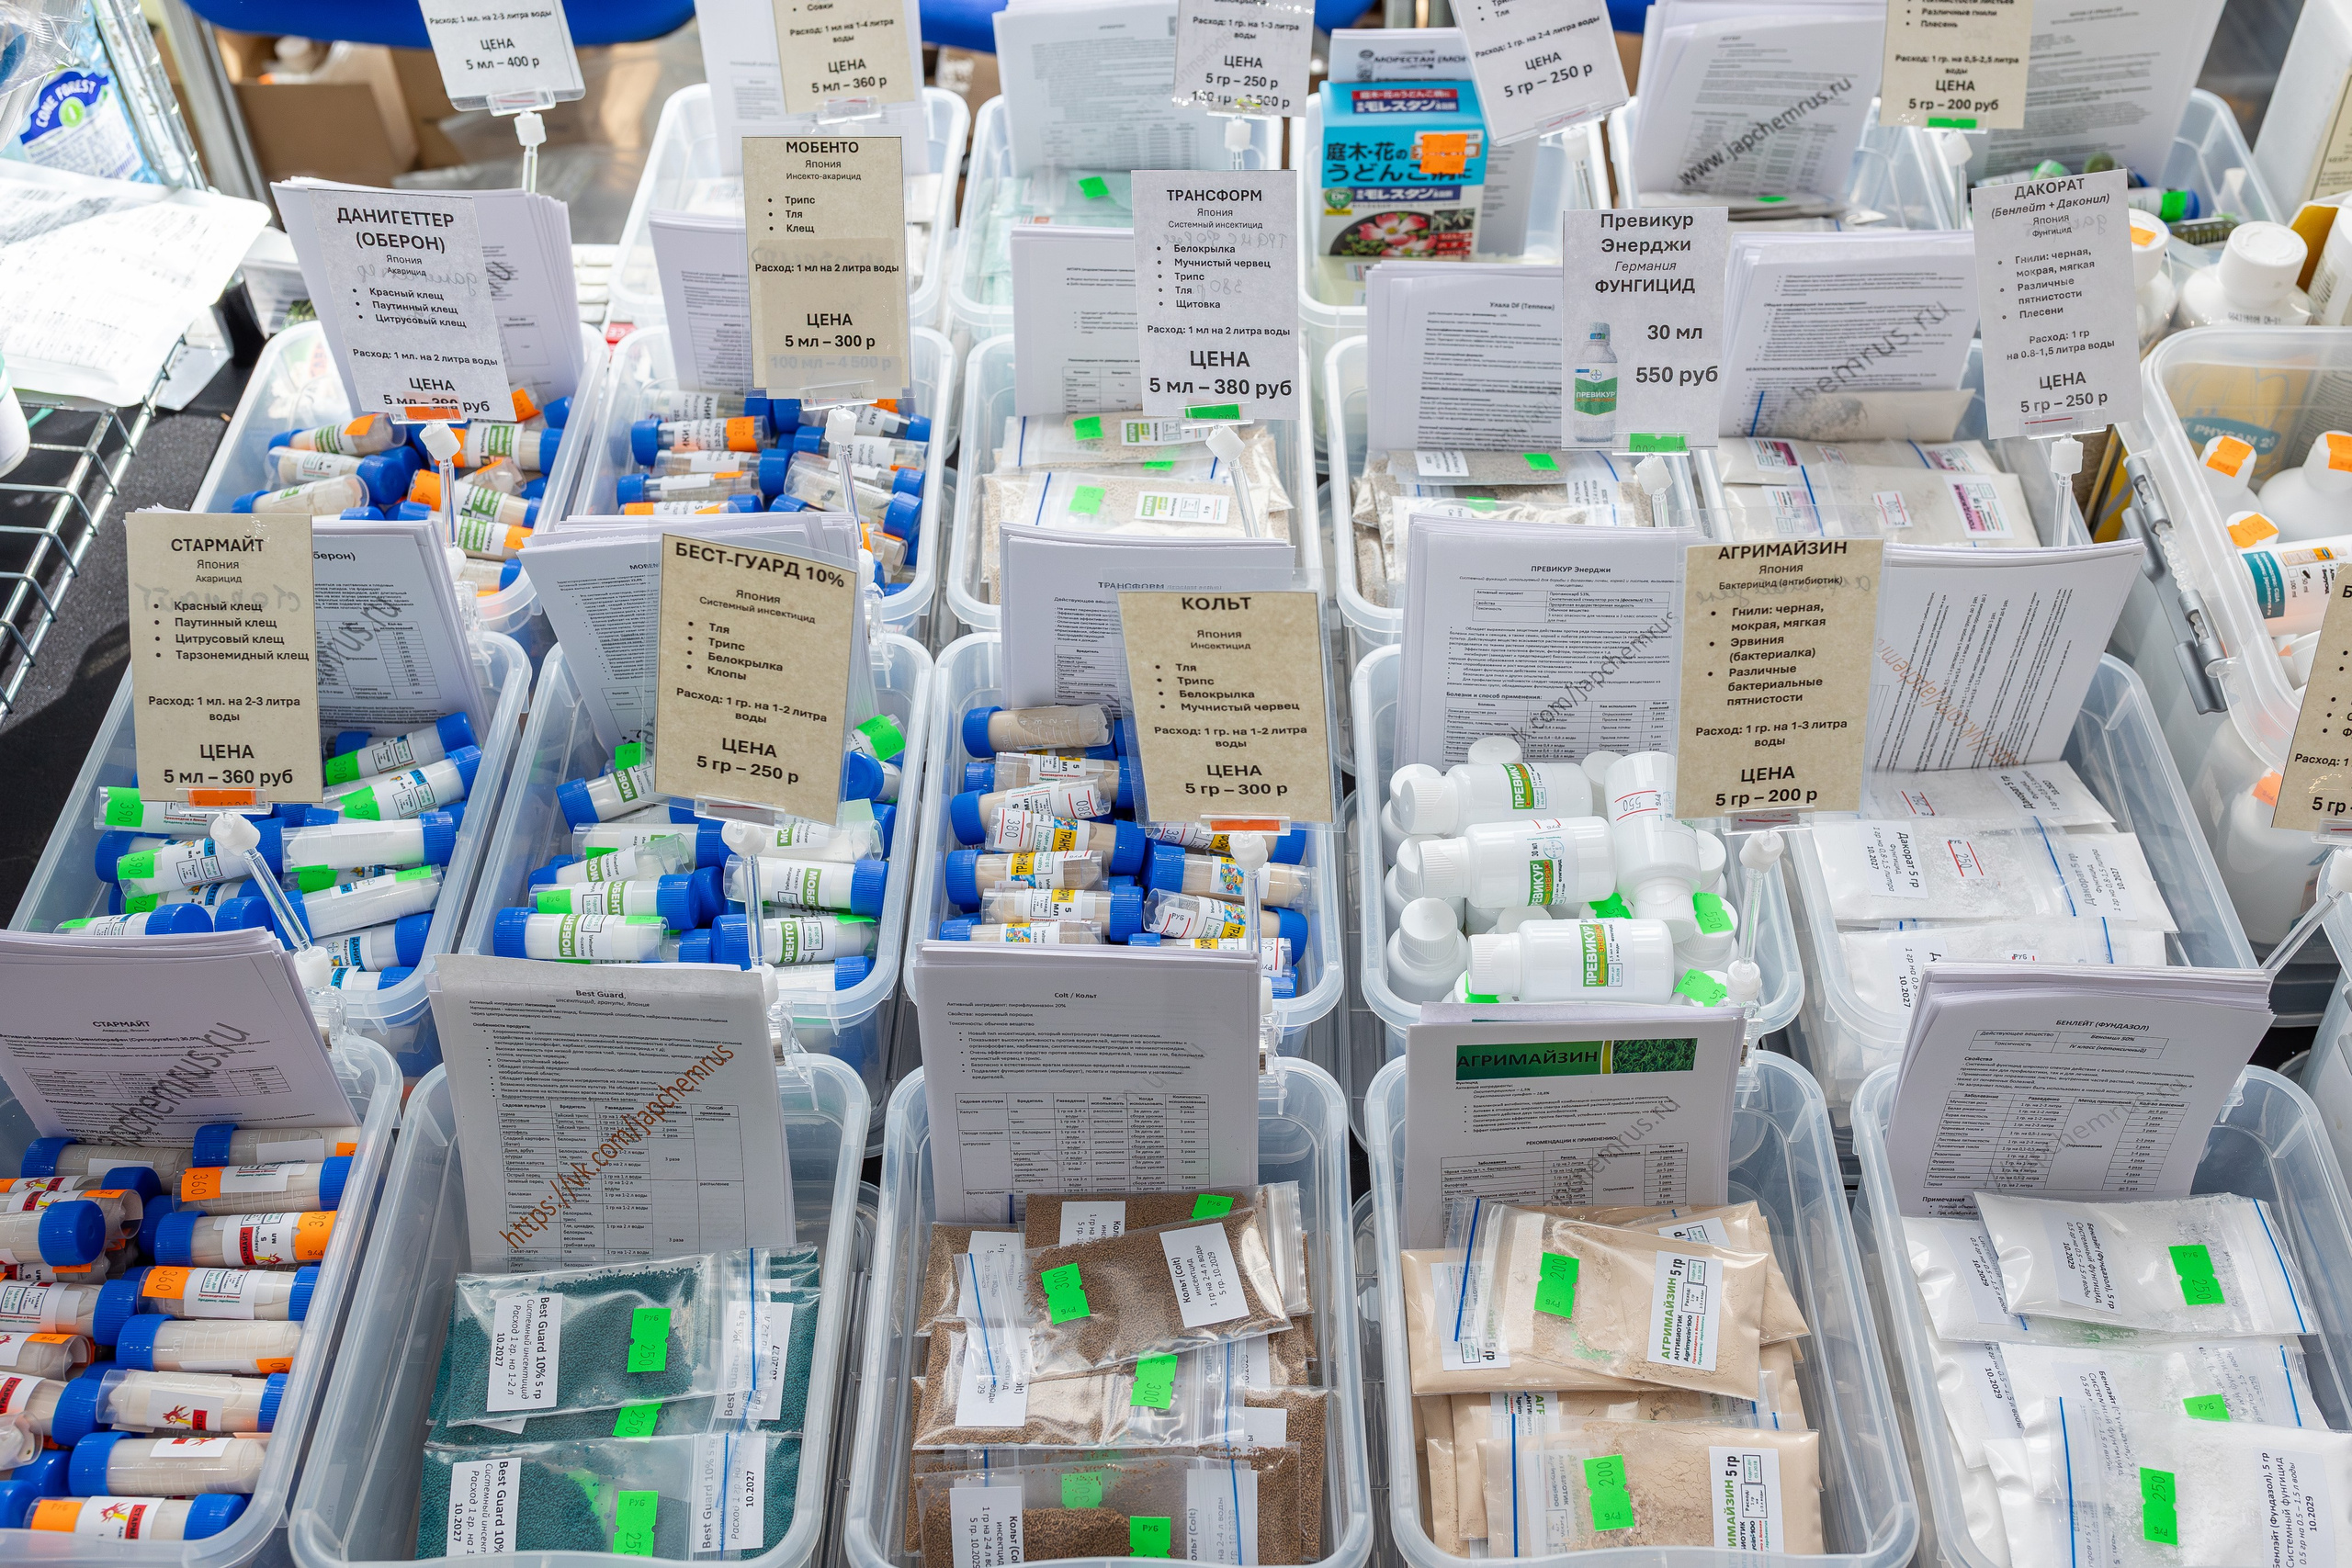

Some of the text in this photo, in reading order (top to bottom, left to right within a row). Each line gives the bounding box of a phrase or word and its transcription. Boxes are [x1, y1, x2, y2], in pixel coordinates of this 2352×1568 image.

[480, 38, 515, 52] ЦЕНА
[507, 55, 529, 67] 400
[828, 58, 866, 74] ЦЕНА
[1224, 55, 1263, 69] ЦЕНА
[1525, 51, 1562, 71] ЦЕНА
[853, 76, 876, 89] 360
[1243, 75, 1267, 87] 250
[1550, 65, 1578, 84] 250
[1935, 80, 1975, 93] ЦЕНА
[1947, 98, 1999, 113] 200 руб
[1679, 77, 1852, 186] www.japchemrus.ru
[786, 141, 859, 153] МОБЕНТО
[805, 159, 842, 168] Япония
[786, 173, 862, 181] Инсекто-акарицид
[1166, 189, 1262, 202] ТРАНСФОРМ
[2014, 177, 2085, 200] ДАКОРАТ
[785, 196, 816, 206] Трипс
[1991, 193, 2110, 220] (Бенлейт Даконил)
[336, 207, 454, 228] ДАНИГЕТТЕР
[1197, 208, 1233, 217] Япония
[2032, 214, 2070, 226] Япония
[786, 224, 815, 234] Клещ
[1168, 220, 1214, 229] Системный
[1600, 213, 1693, 231] Превикур
[2032, 227, 2073, 239] Фунгицид
[356, 231, 445, 254] (ОБЕРОН)
[1174, 243, 1236, 254] Белокрылка
[1601, 238, 1690, 255] Энерджи
[386, 254, 423, 265] Япония
[1174, 258, 1272, 269] Мучнистый червец
[2015, 249, 2092, 265] Гнили: черная,
[387, 266, 427, 277] Акарицид
[755, 264, 899, 274] Расход: литра воды
[1614, 261, 1677, 274] Германия
[2016, 261, 2095, 277] мокрая, мягкая
[1174, 272, 1204, 282] Трипс
[2018, 278, 2075, 292] Различные
[1595, 278, 1695, 294] ФУНГИЦИД
[369, 288, 445, 301] Красный клещ
[2018, 290, 2082, 305] пятнистости
[372, 300, 429, 312] Паутинный
[1176, 299, 1221, 310] Щитовка
[375, 313, 437, 325] Цитрусовый
[807, 313, 854, 329] ЦЕНА
[2019, 307, 2064, 319] Плесени
[1147, 325, 1290, 337] Расход: литра воды
[1647, 324, 1670, 340] 30
[2030, 333, 2069, 344] Расход:
[834, 334, 862, 347] 300
[353, 348, 392, 360] Расход:
[1190, 350, 1250, 370] ЦЕНА
[1635, 365, 1718, 387] 550 руб
[2040, 371, 2086, 390] ЦЕНА
[409, 378, 456, 391] ЦЕНА
[1215, 378, 1292, 400] 380 руб
[2065, 392, 2094, 408] 250
[171, 535, 264, 552] СТАРМАЙТ
[1717, 540, 1848, 560] АГРИМАЙЗИН
[197, 558, 240, 570] Япония
[675, 542, 847, 588] БЕСТ-ГУАРД 10%
[1574, 566, 1611, 574] Энерджи
[1719, 576, 1843, 591] Бактерицид (антибиотик)
[735, 589, 781, 604] Япония
[1182, 597, 1251, 611] КОЛЬТ
[699, 596, 816, 625] Системный инсектицид
[1197, 629, 1242, 638] Япония
[1190, 642, 1251, 650] Инсектицид
[1730, 637, 1784, 649] Эрвиния
[175, 649, 274, 661] Тарзонемидный
[707, 651, 783, 671] Белокрылка
[1729, 647, 1815, 664] (бактериалка)
[707, 666, 747, 681] Клопы
[1727, 679, 1823, 692] бактериальные
[148, 695, 195, 707] Расход:
[200, 744, 254, 761] ЦЕНА
[722, 738, 777, 758] ЦЕНА
[222, 769, 254, 784] 360
[334, 760, 347, 780] 390
[750, 763, 783, 780] 250
[1206, 764, 1262, 778] ЦЕНА
[1741, 765, 1795, 784] ЦЕНА
[1238, 784, 1272, 795] 300
[1768, 788, 1801, 803] 200
[1076, 800, 1091, 817] 380
[1623, 795, 1642, 811] 550
[117, 802, 134, 823] 390
[1867, 846, 1880, 870] 10.2027
[1895, 831, 1915, 869] Дакорат
[1889, 843, 1902, 874] фунгицид
[1956, 853, 1973, 869] 250
[781, 920, 797, 964] ОБЕНТО
[1581, 925, 1598, 985] ПРЕВИКУР
[575, 989, 627, 999] Best Guard,
[1899, 976, 1911, 1008] 10.2027
[92, 1020, 150, 1028] СТАРМАЙТ
[2095, 1021, 2150, 1032] (ФУНДАЗОЛ)
[1456, 1051, 1599, 1068] АГРИМАЙЗИН
[498, 1043, 734, 1249] https://vk.com/japchemrus
[1577, 1135, 1619, 1144] ПРИМЕНЕНИЮ:
[191, 1174, 209, 1195] 360
[1922, 1196, 1965, 1204] Примечания
[2086, 1223, 2100, 1249] Бенлэйт
[1209, 1250, 1222, 1278] 10.2029
[2063, 1242, 2075, 1270] 10.2029
[1188, 1258, 1202, 1296] инсектицид
[1550, 1258, 1567, 1280] 200
[1973, 1259, 1989, 1288] 10.2029
[1053, 1270, 1070, 1291] 300
[1171, 1257, 1191, 1304] Кольт (Colt)
[2088, 1264, 2103, 1303] фунгицид
[2192, 1279, 2211, 1300] 250
[511, 1304, 522, 1334] Расход
[1661, 1277, 1677, 1359] АГРИМАЙЗИН
[535, 1297, 550, 1379] Best Guard 10%
[1674, 1314, 1683, 1360] АНТИБИОТИК
[495, 1333, 505, 1367] 10.2027
[520, 1299, 535, 1400] Системный инсектицид
[639, 1344, 656, 1366] 250
[1144, 1382, 1159, 1404] 300
[2152, 1475, 2166, 1502] 250
[2305, 1495, 2317, 1532] 10.2029
[453, 1503, 463, 1542] 10.2027
[1009, 1516, 1018, 1544] Кольт
[1142, 1524, 1159, 1533] РУБ
